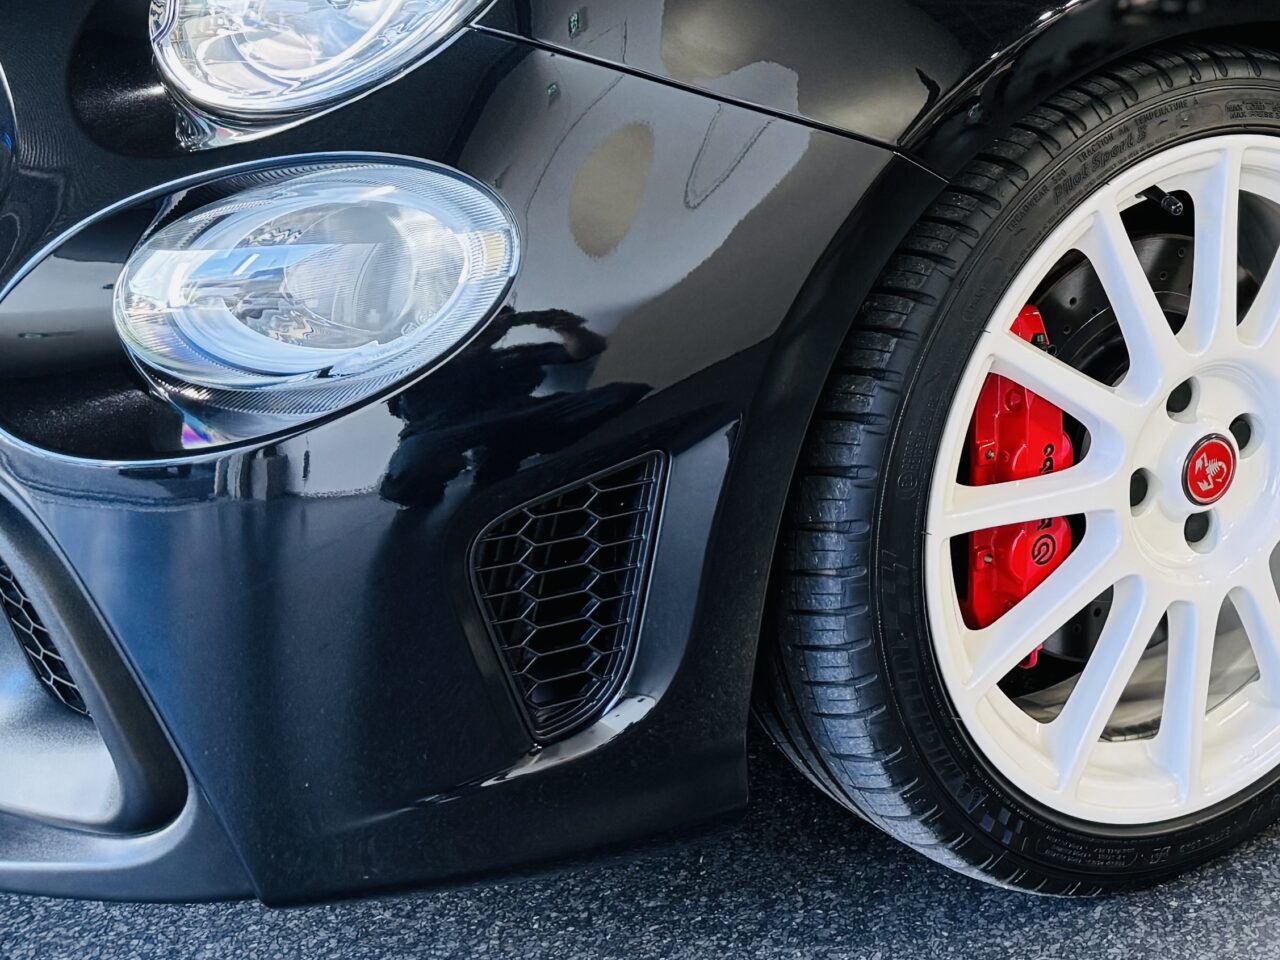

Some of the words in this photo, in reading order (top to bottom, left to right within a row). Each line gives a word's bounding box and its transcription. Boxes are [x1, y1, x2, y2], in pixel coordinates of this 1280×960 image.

[1053, 166, 1089, 205] Pilot
[1091, 132, 1134, 173] Sport
[1076, 132, 1115, 163] TRACTION
